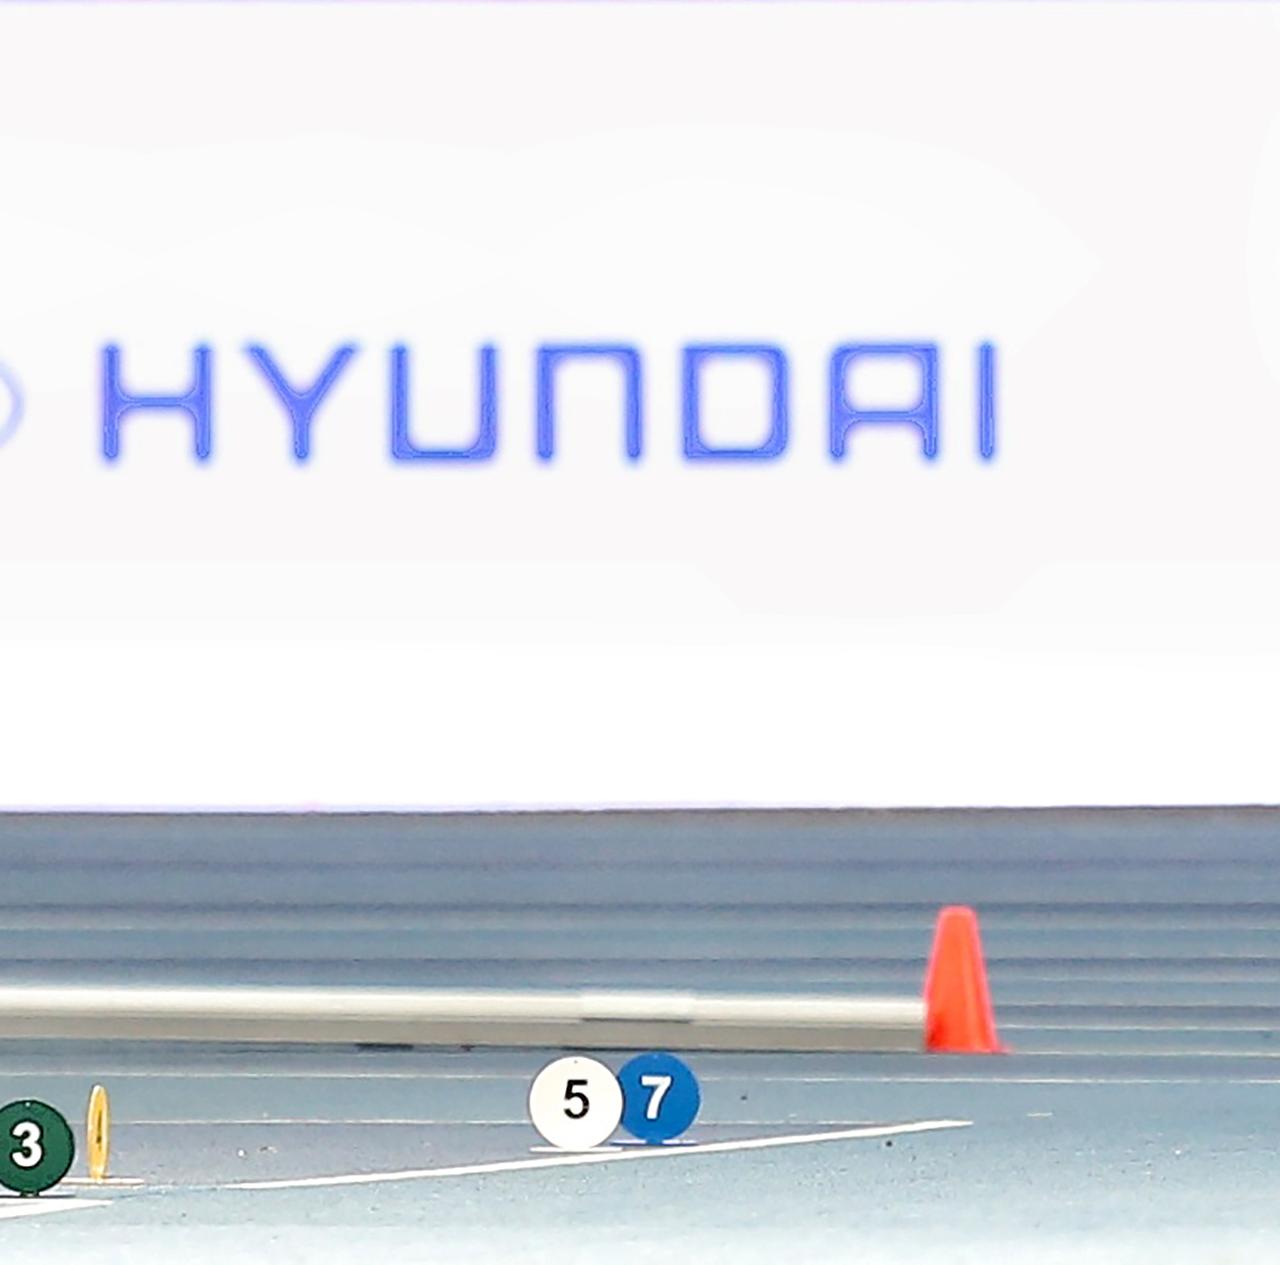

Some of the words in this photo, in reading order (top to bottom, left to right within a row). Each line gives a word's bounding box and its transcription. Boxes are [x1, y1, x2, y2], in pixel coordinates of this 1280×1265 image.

[100, 340, 1000, 463] HYUNDAI
[563, 1079, 589, 1118] 5
[641, 1075, 671, 1119] 7
[12, 1123, 42, 1169] 3
